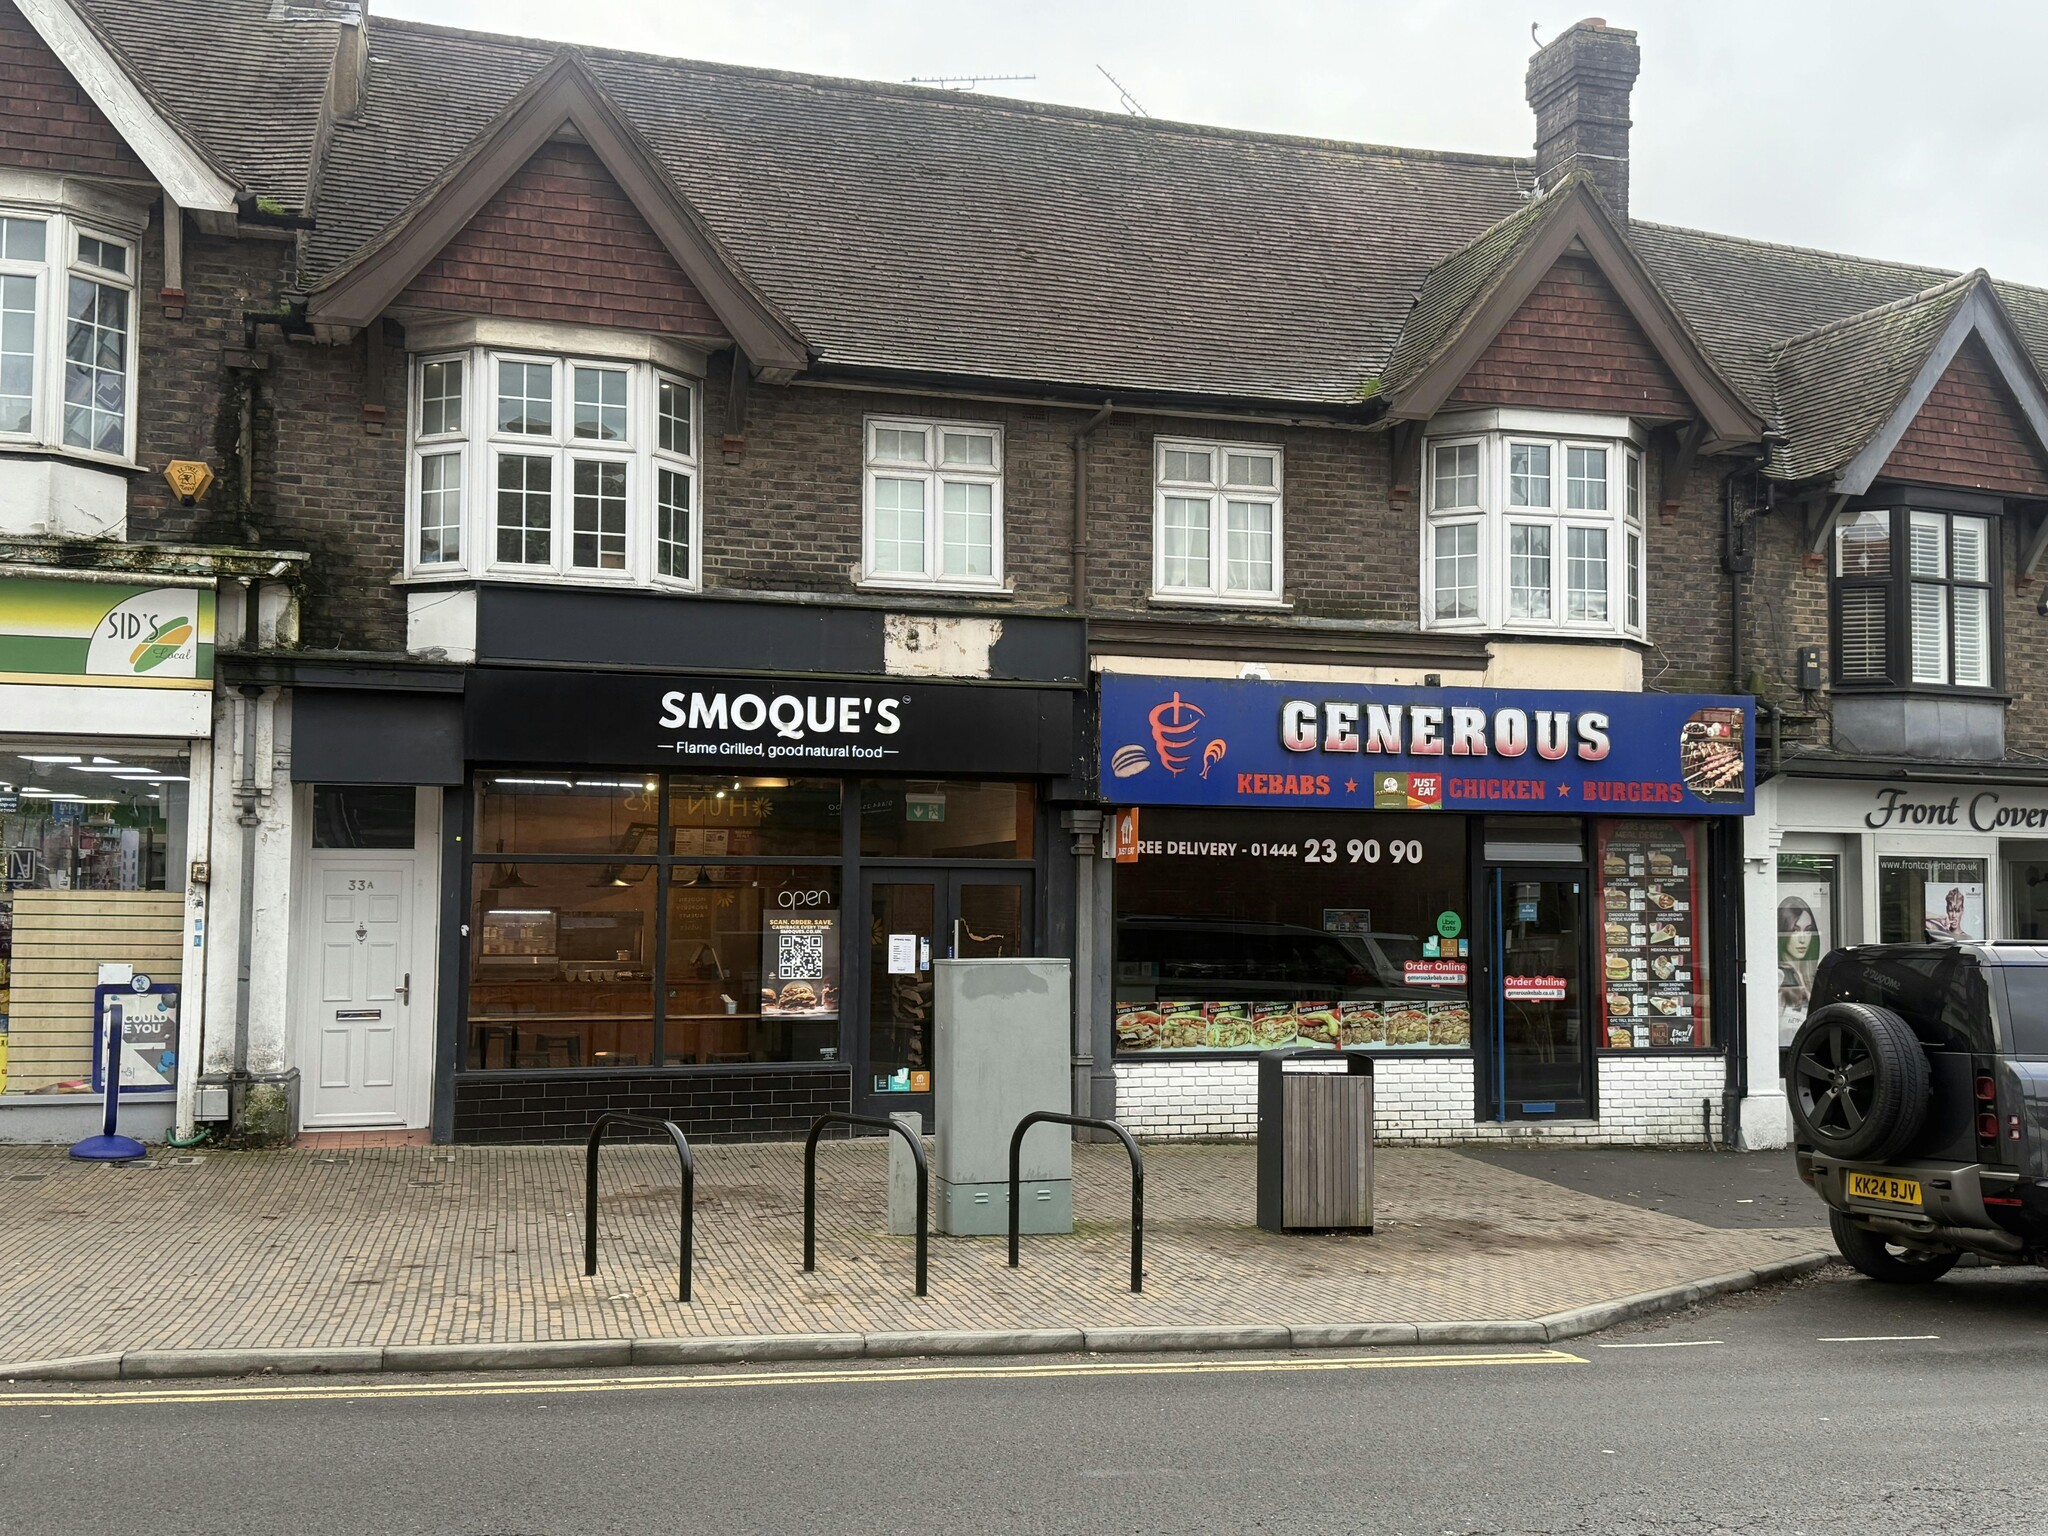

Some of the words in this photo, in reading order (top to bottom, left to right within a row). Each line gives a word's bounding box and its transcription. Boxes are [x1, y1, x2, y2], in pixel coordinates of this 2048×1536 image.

[107, 612, 160, 640] SID'S
[153, 648, 193, 661] Local
[658, 690, 901, 740] SMOQUE'S
[1280, 699, 1611, 761] GENEROUS
[676, 741, 717, 755] Flame
[720, 742, 766, 758] Grilled,
[767, 744, 803, 759] good
[805, 743, 849, 757] natural
[851, 745, 883, 758] food
[1237, 773, 1331, 796] KEBABS
[1412, 778, 1437, 789] JUST
[1418, 787, 1439, 797] EAT
[1449, 777, 1545, 800] CHICKEN
[1583, 780, 1683, 803] BURGERS
[1864, 788, 1960, 829] Front
[1137, 840, 1162, 855] REE
[1167, 841, 1238, 857] DELIVERY
[1250, 842, 1298, 858] 01444
[1304, 839, 1338, 863] 23
[1348, 839, 1381, 864] 90
[1389, 839, 1423, 864] 90
[1880, 860, 1978, 872] www.frontcoverhair.co.uk
[348, 880, 374, 891] 33A
[778, 890, 830, 910] open
[1405, 962, 1433, 971] Order
[1435, 962, 1466, 971] Online
[1505, 977, 1533, 986] Order
[1534, 977, 1565, 987] Online
[124, 1014, 167, 1023] COULD
[124, 1024, 132, 1034] E
[134, 1024, 161, 1034] YOU
[1854, 1176, 1887, 1195] KK24
[1891, 1181, 1917, 1202] BJV
